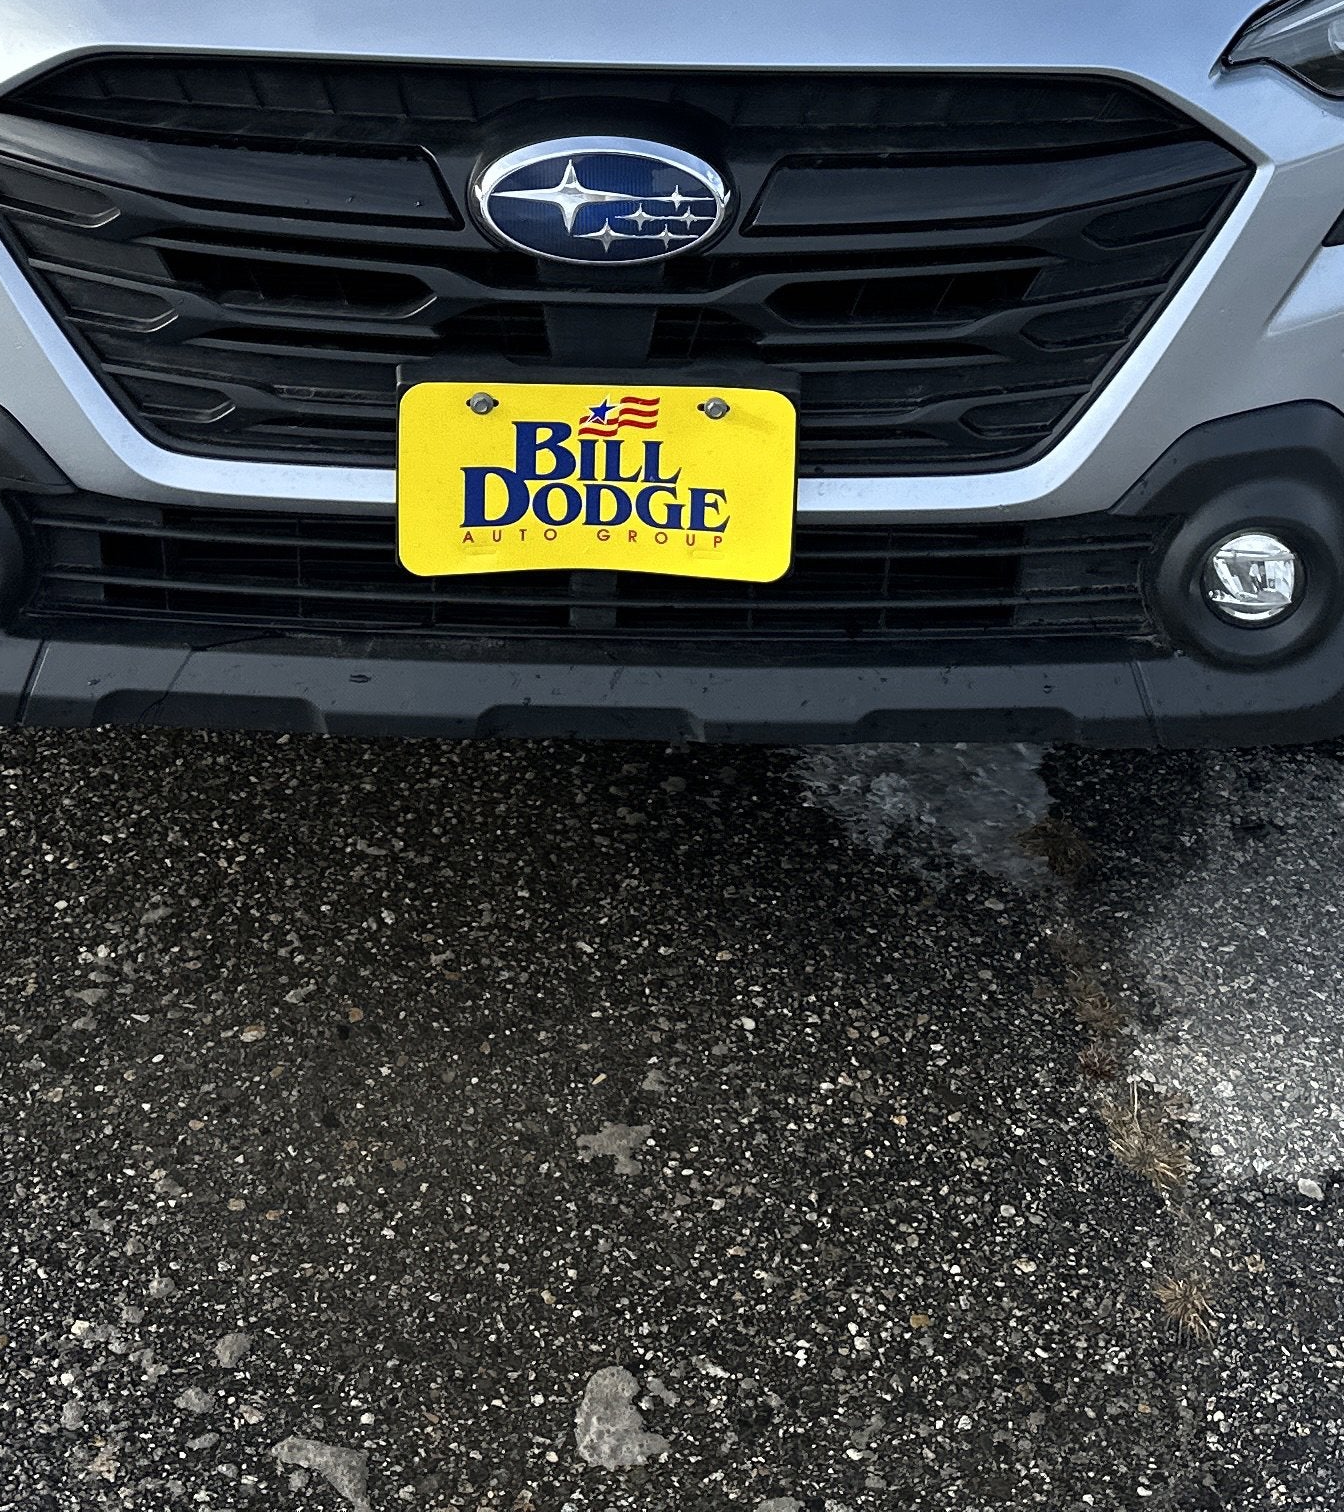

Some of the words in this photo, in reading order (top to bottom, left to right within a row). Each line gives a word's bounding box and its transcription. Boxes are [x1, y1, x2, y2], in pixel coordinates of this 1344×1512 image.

[511, 420, 682, 484] BILL
[459, 466, 731, 533] DODGE
[461, 528, 559, 544] AUTO
[596, 528, 724, 549] GROUP
